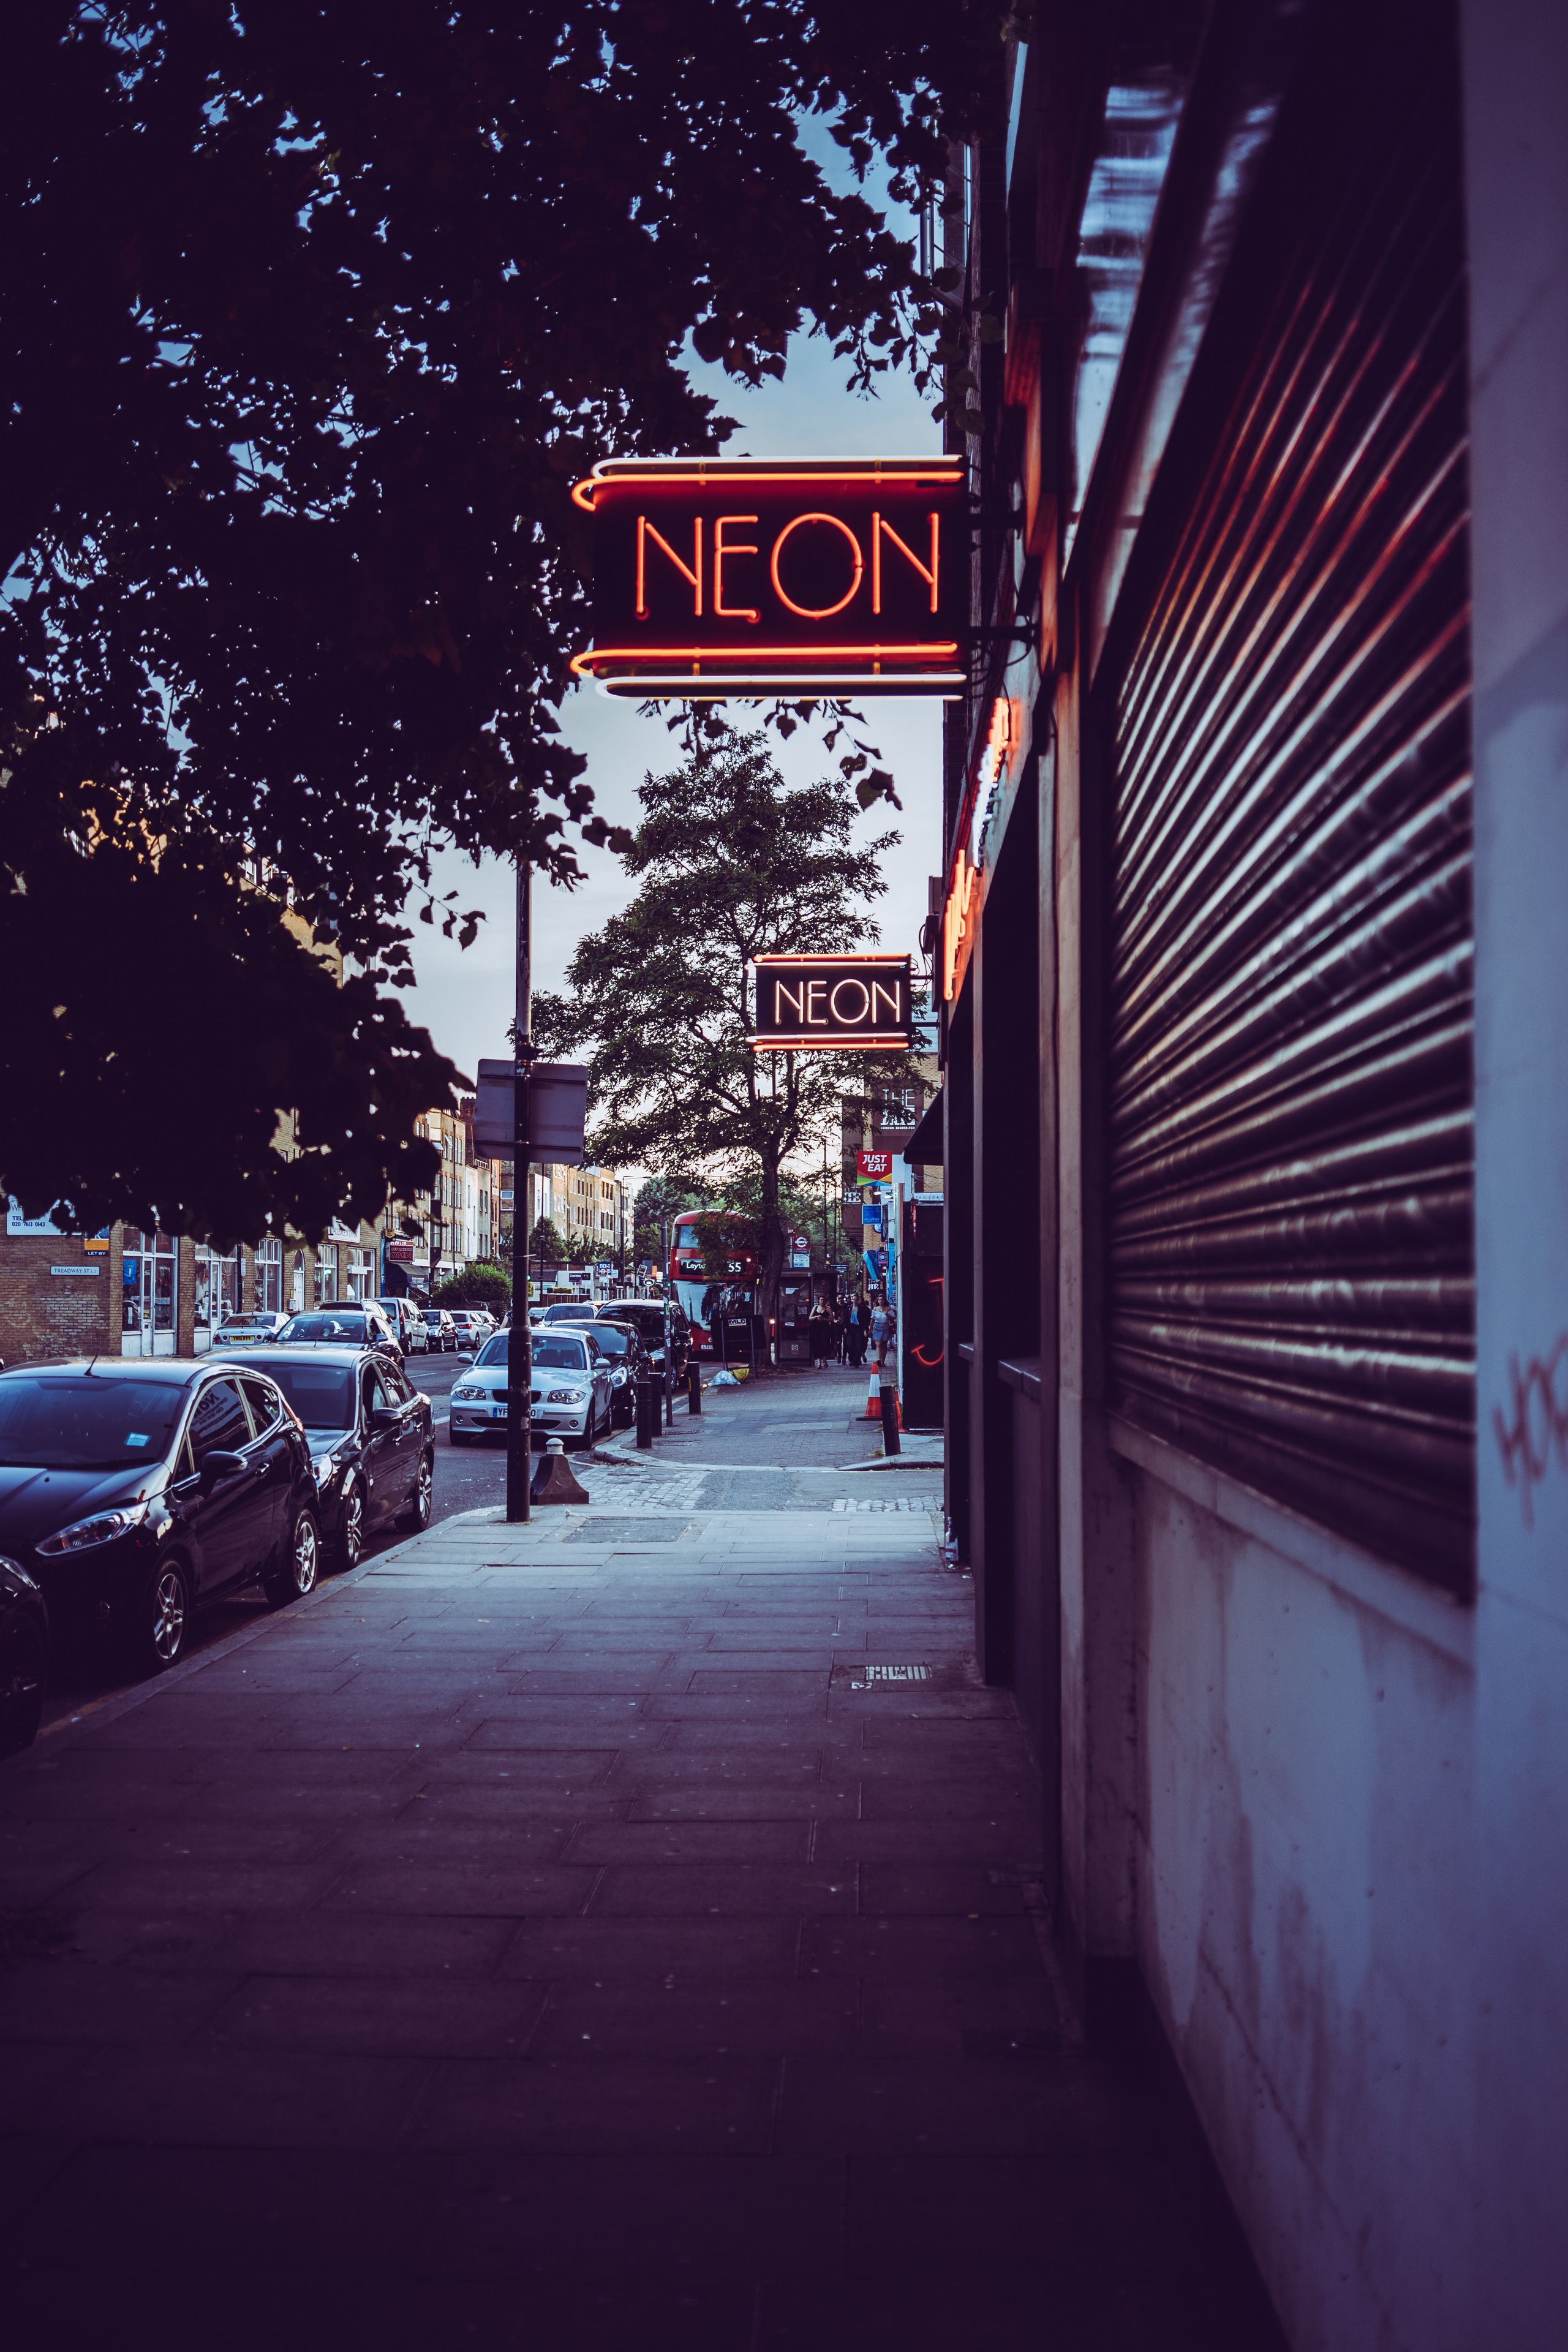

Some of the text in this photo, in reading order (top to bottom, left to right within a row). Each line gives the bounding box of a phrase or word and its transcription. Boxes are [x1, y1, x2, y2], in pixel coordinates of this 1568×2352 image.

[636, 512, 940, 620] NEON
[774, 978, 901, 1025] NEON
[882, 1089, 915, 1107] THE
[862, 1155, 887, 1164] JUST
[728, 1262, 742, 1272] 55
